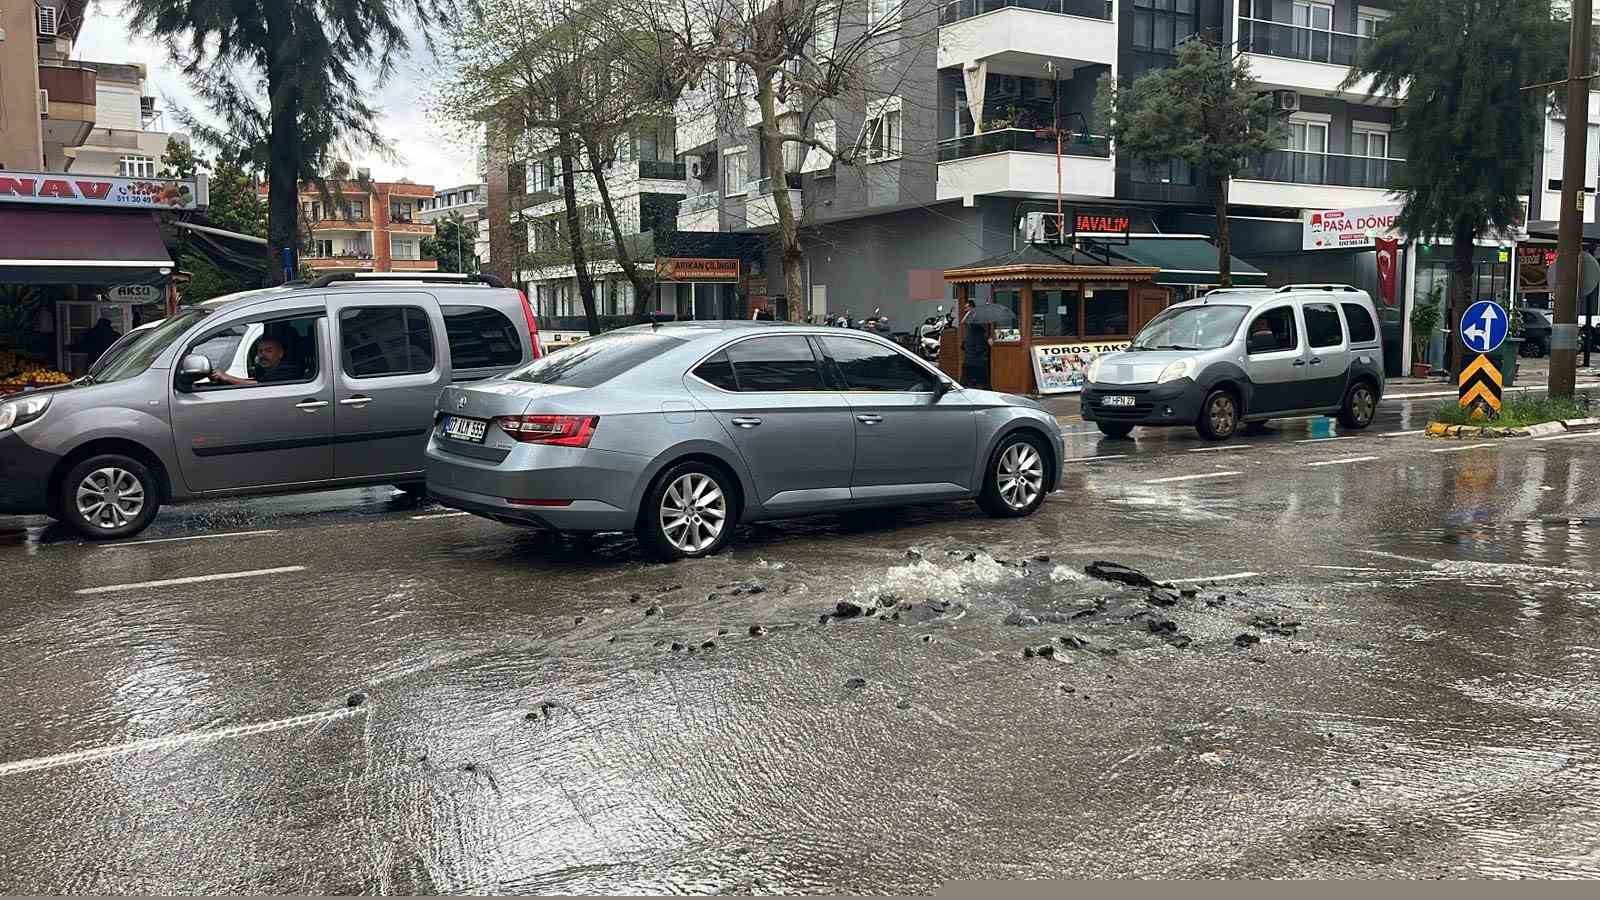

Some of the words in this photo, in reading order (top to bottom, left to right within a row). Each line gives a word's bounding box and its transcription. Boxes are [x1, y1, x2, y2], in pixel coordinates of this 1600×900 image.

[1323, 219, 1353, 233] PAŞA
[118, 286, 150, 296] AKSU
[1041, 346, 1090, 355] TOROS
